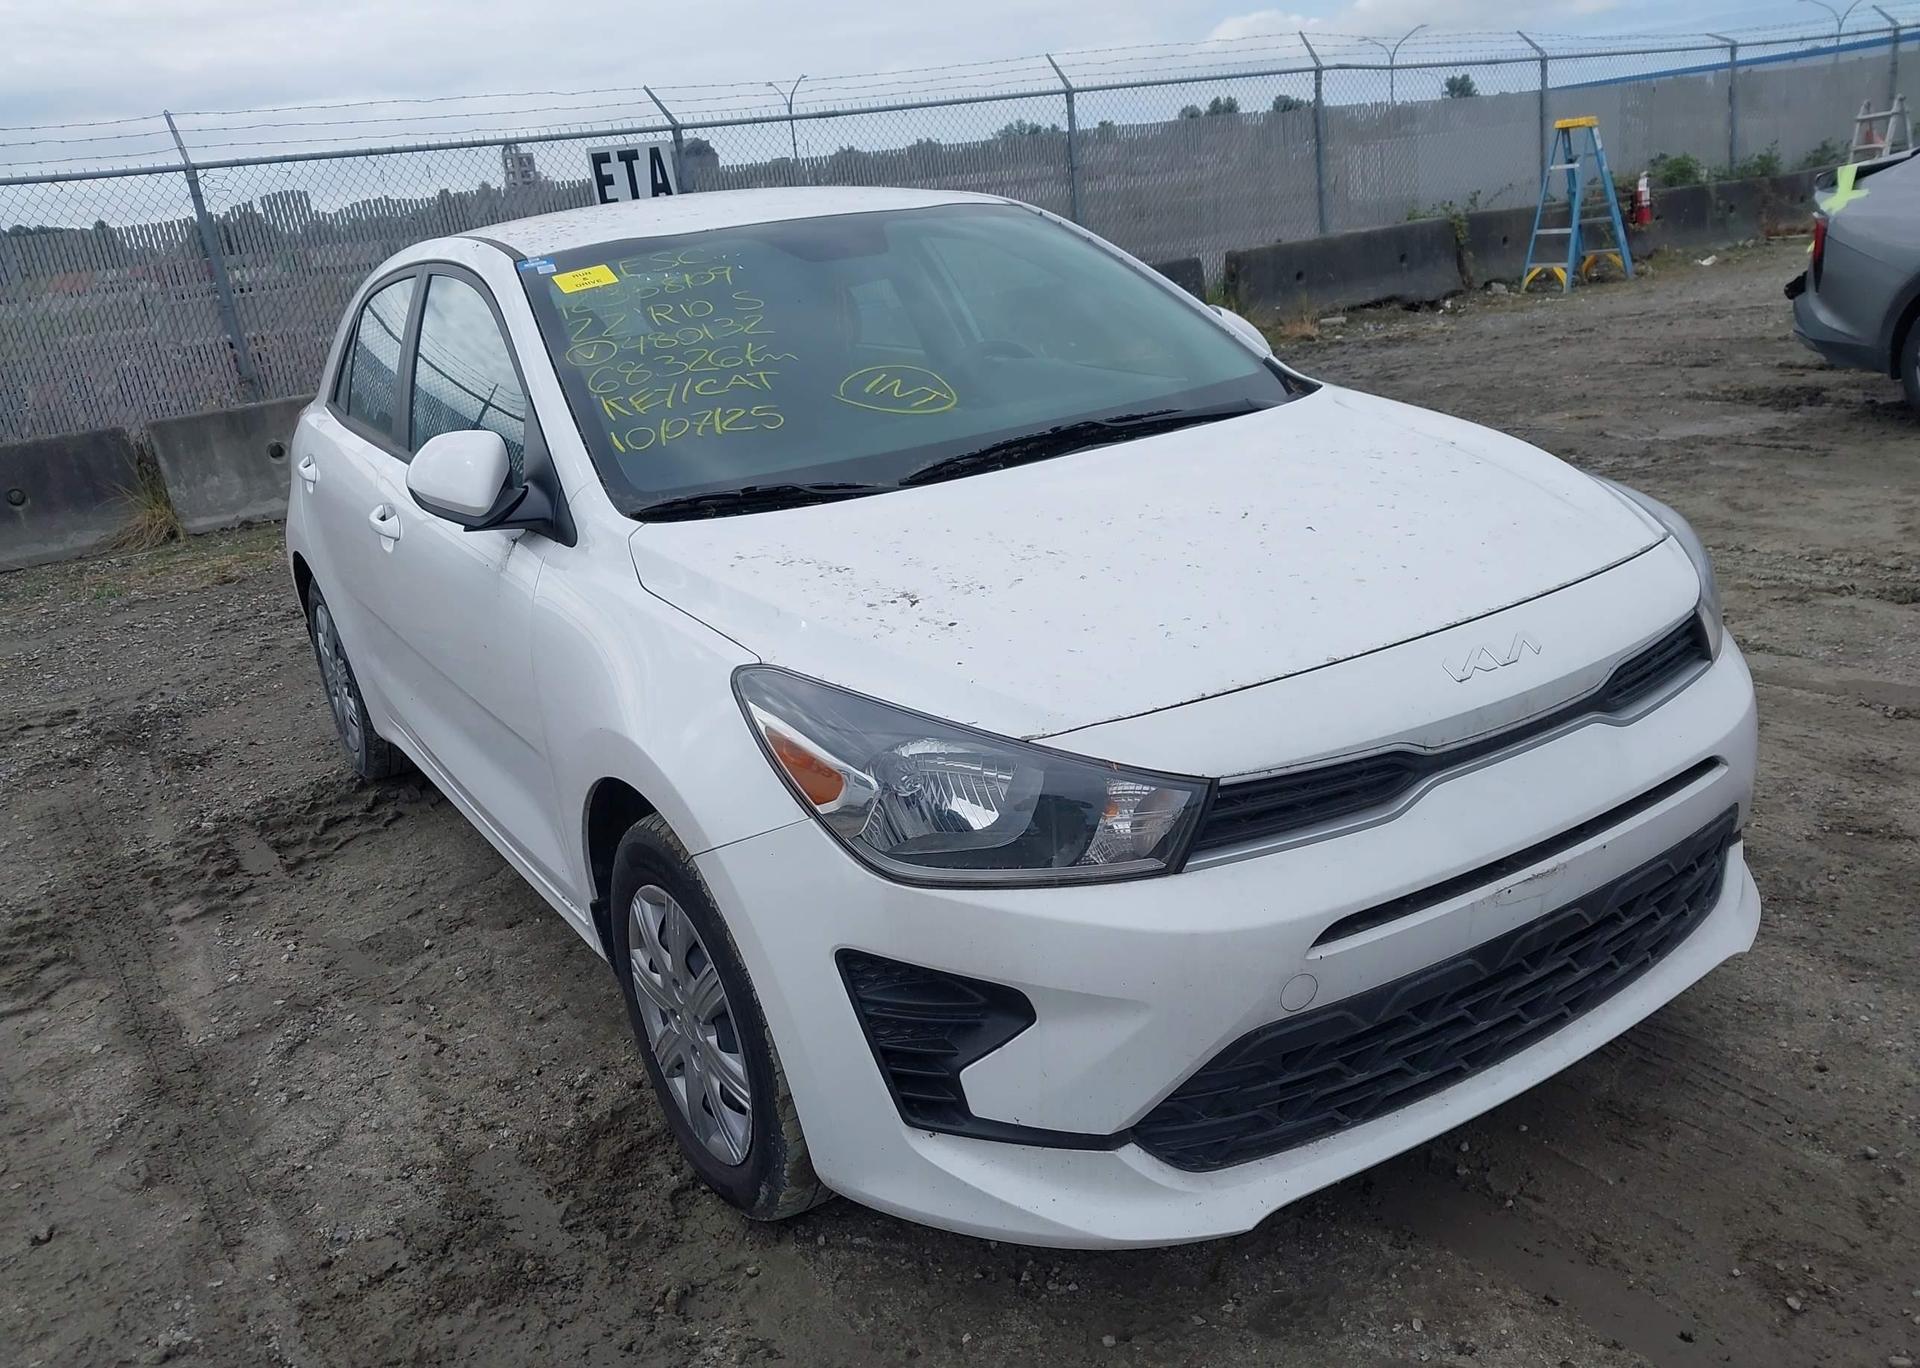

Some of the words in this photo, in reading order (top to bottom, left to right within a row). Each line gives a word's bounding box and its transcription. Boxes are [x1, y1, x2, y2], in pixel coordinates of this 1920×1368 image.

[592, 147, 673, 204] ETA
[575, 279, 603, 287] DRIVE
[732, 291, 765, 311] S
[864, 373, 952, 408] INT
